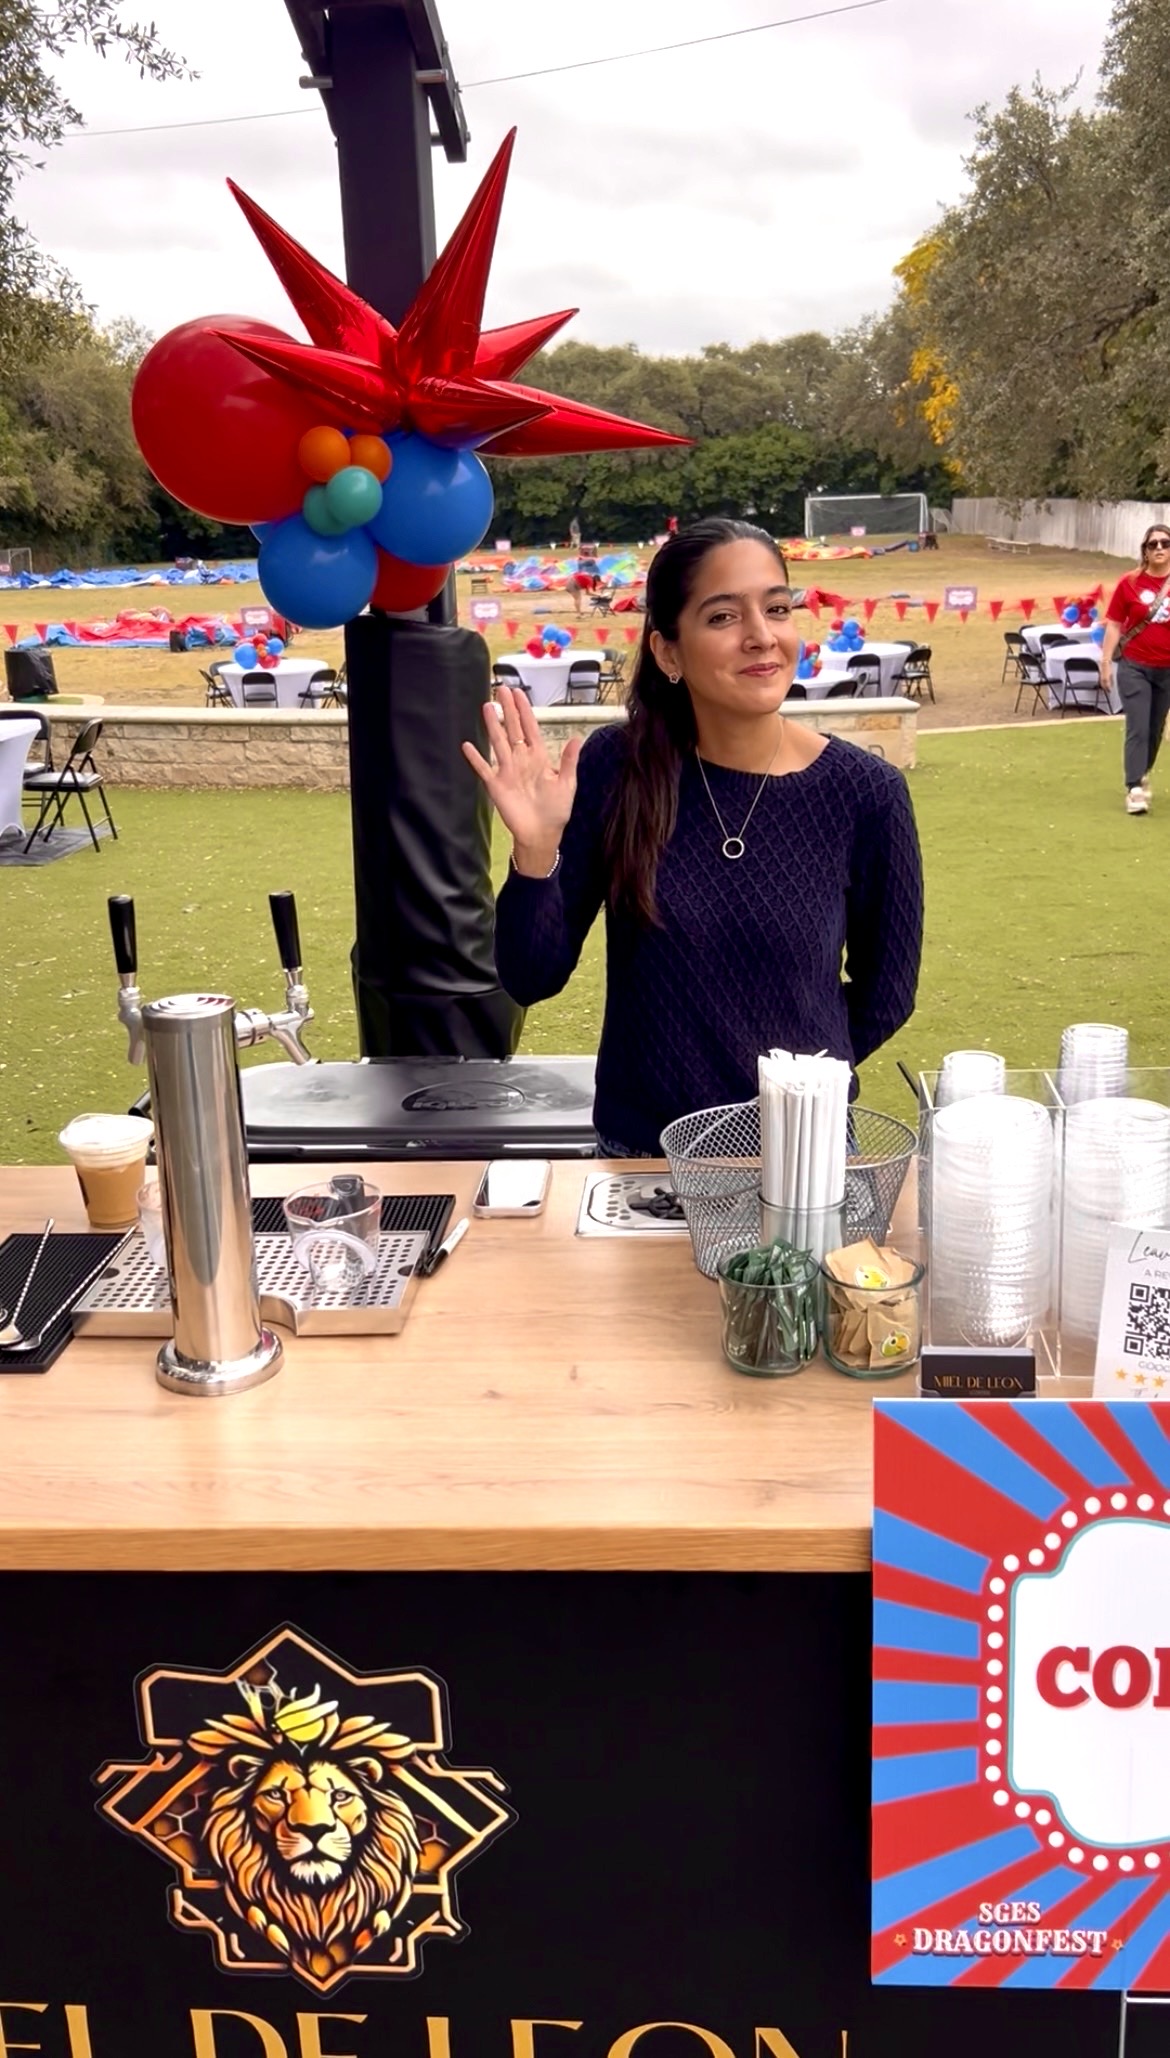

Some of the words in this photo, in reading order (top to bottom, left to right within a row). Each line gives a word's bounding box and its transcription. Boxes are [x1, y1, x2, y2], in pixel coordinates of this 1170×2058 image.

[1145, 1269, 1152, 1277] A
[1154, 1270, 1170, 1280] RE
[934, 1375, 963, 1388] MIEL
[967, 1376, 984, 1389] DE
[987, 1376, 1023, 1390] LEON
[978, 1901, 1042, 1926] SGES
[912, 1927, 1107, 1958] DRAGONFEST
